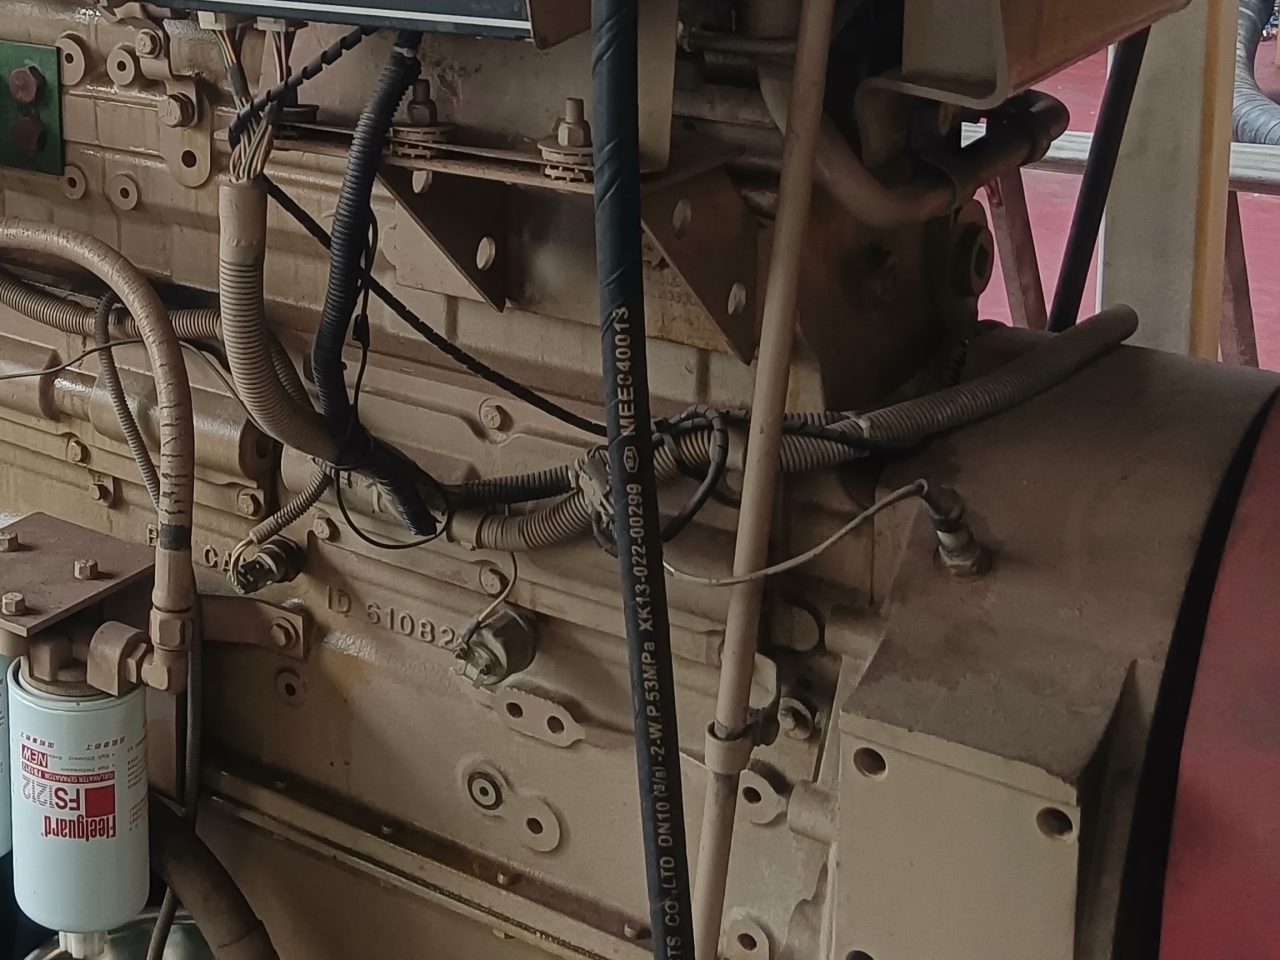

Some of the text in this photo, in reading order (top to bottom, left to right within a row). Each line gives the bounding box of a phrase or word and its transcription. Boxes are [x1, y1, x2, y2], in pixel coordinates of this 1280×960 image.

[626, 483, 654, 632] XK13-022-00299
[326, 584, 353, 615] ID
[23, 747, 48, 767] NEW
[43, 814, 117, 842] Fleetguard
[651, 802, 673, 848] DN10
